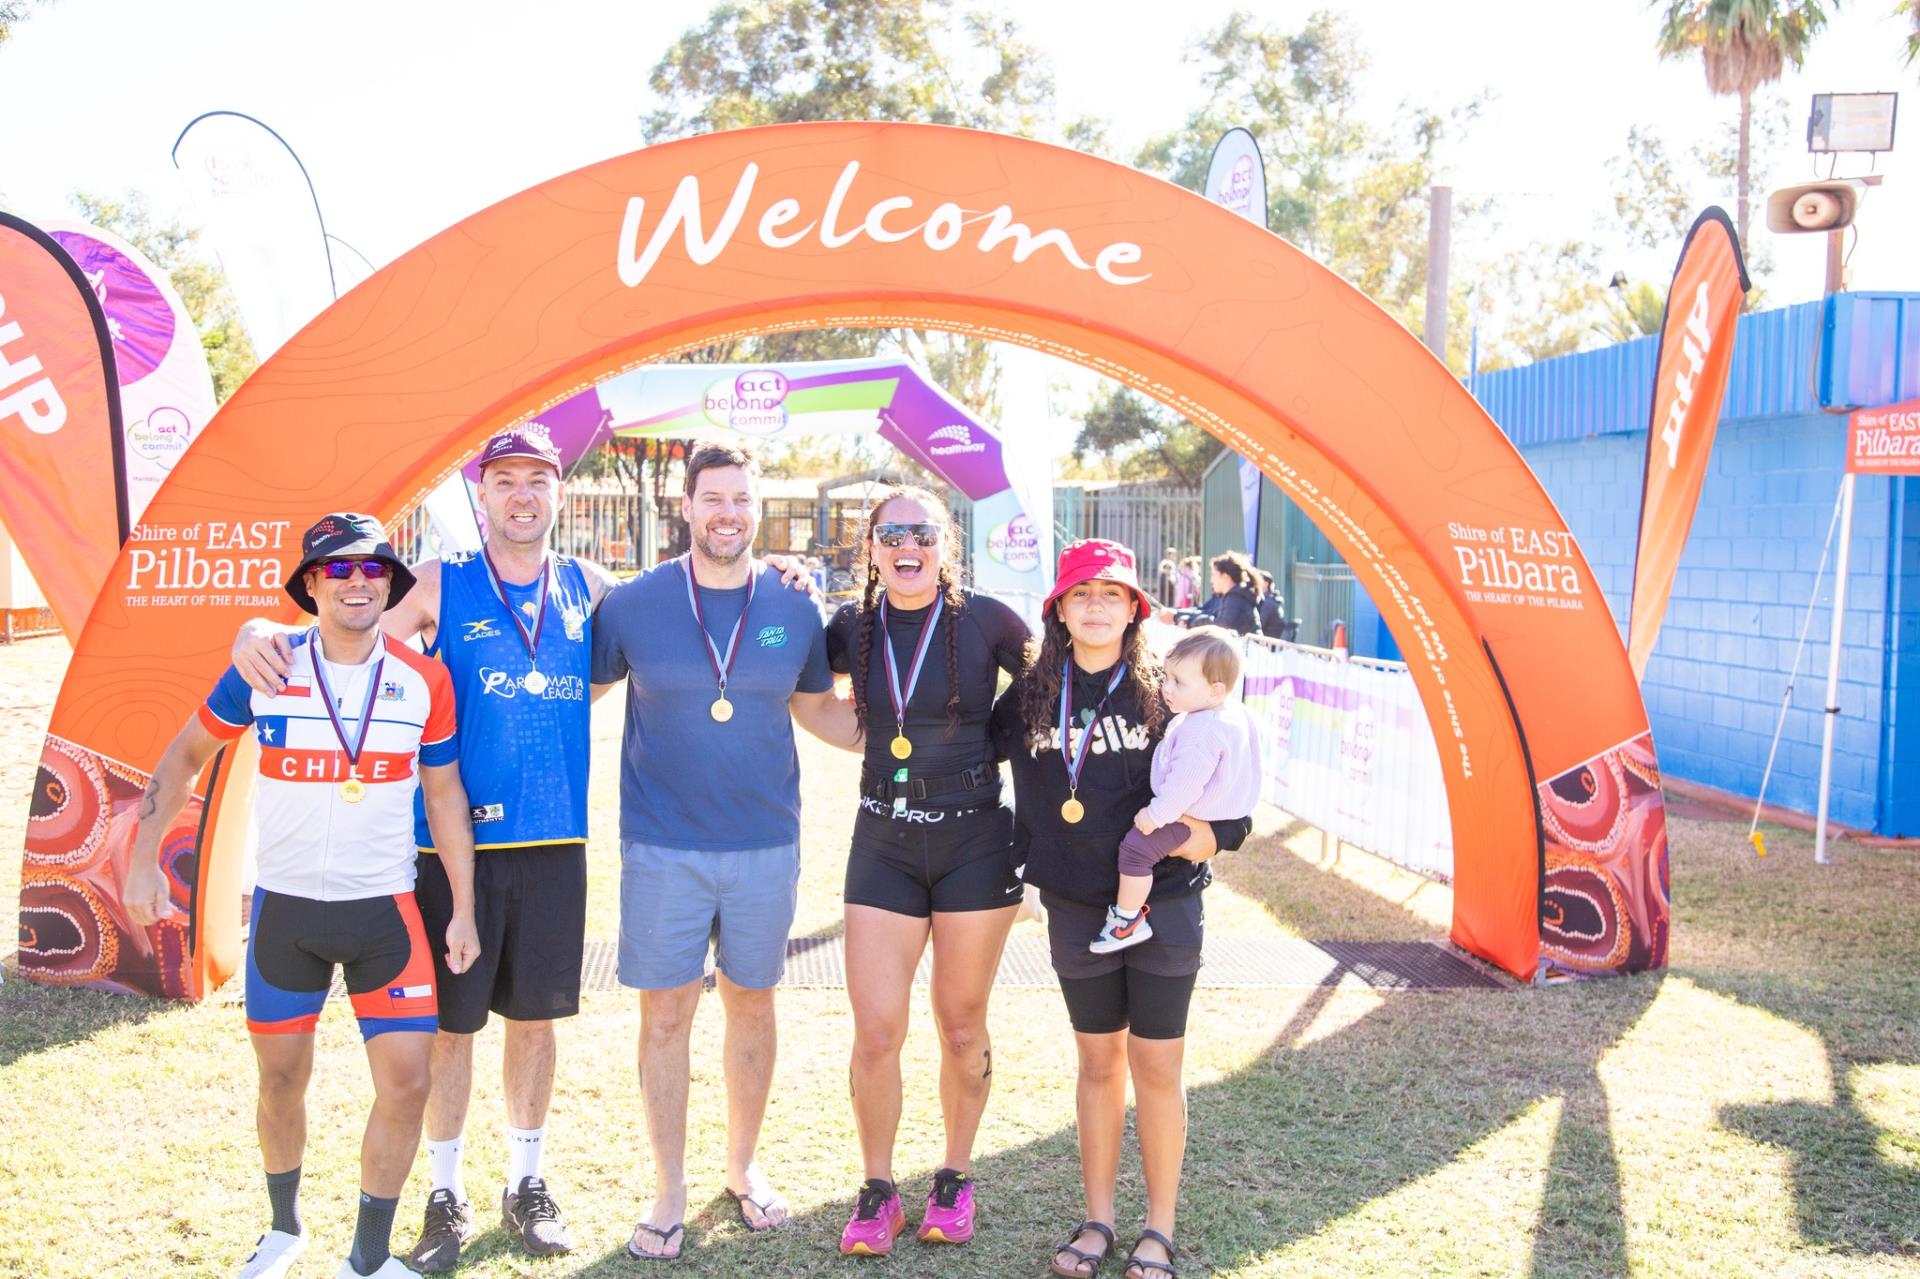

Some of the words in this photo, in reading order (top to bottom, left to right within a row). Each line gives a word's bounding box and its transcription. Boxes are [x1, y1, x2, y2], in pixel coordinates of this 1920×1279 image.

[617, 160, 1153, 287] Welcome
[977, 325, 1090, 359] Aboriginal
[0, 292, 68, 434] HP
[1092, 355, 1150, 384] these
[1661, 281, 1711, 469] BHP
[740, 378, 781, 392] act
[1150, 382, 1175, 395] of
[134, 432, 173, 443] belong
[158, 425, 177, 433] act
[1178, 393, 1265, 454] members
[142, 443, 183, 451] commit
[930, 442, 986, 456] healthway
[1264, 451, 1298, 479] the
[1298, 478, 1320, 496] to
[130, 523, 178, 541] Shire
[182, 523, 202, 541] of
[205, 521, 290, 550] EAST
[1320, 495, 1386, 561] respects
[1447, 521, 1488, 541] Shire
[1490, 527, 1505, 543] of
[1509, 527, 1574, 558] EAST
[126, 547, 283, 590] Pilbara
[1383, 563, 1411, 593] our
[1453, 545, 1582, 594] Pilbara
[126, 595, 148, 607] THE
[151, 595, 188, 607] HEART
[191, 594, 207, 606] OF
[209, 594, 232, 606] THE
[234, 595, 280, 607] PILBARA
[1372, 561, 1416, 621] Pilbara
[1464, 590, 1484, 603] THE
[1483, 592, 1512, 605] HEART
[1513, 593, 1524, 605] OF
[1526, 595, 1546, 608] THE
[1547, 597, 1584, 610] PILBARA
[1406, 595, 1435, 627] pay
[463, 629, 502, 642] BLADES
[756, 625, 785, 641] SANTA
[1411, 622, 1437, 662] East
[1428, 628, 1449, 662] We
[1431, 664, 1446, 685] of
[542, 688, 584, 701] LEAGUE
[1440, 689, 1464, 739] Shire
[281, 756, 390, 780] CHILE
[1457, 741, 1473, 779] The
[891, 808, 945, 824] PRO
